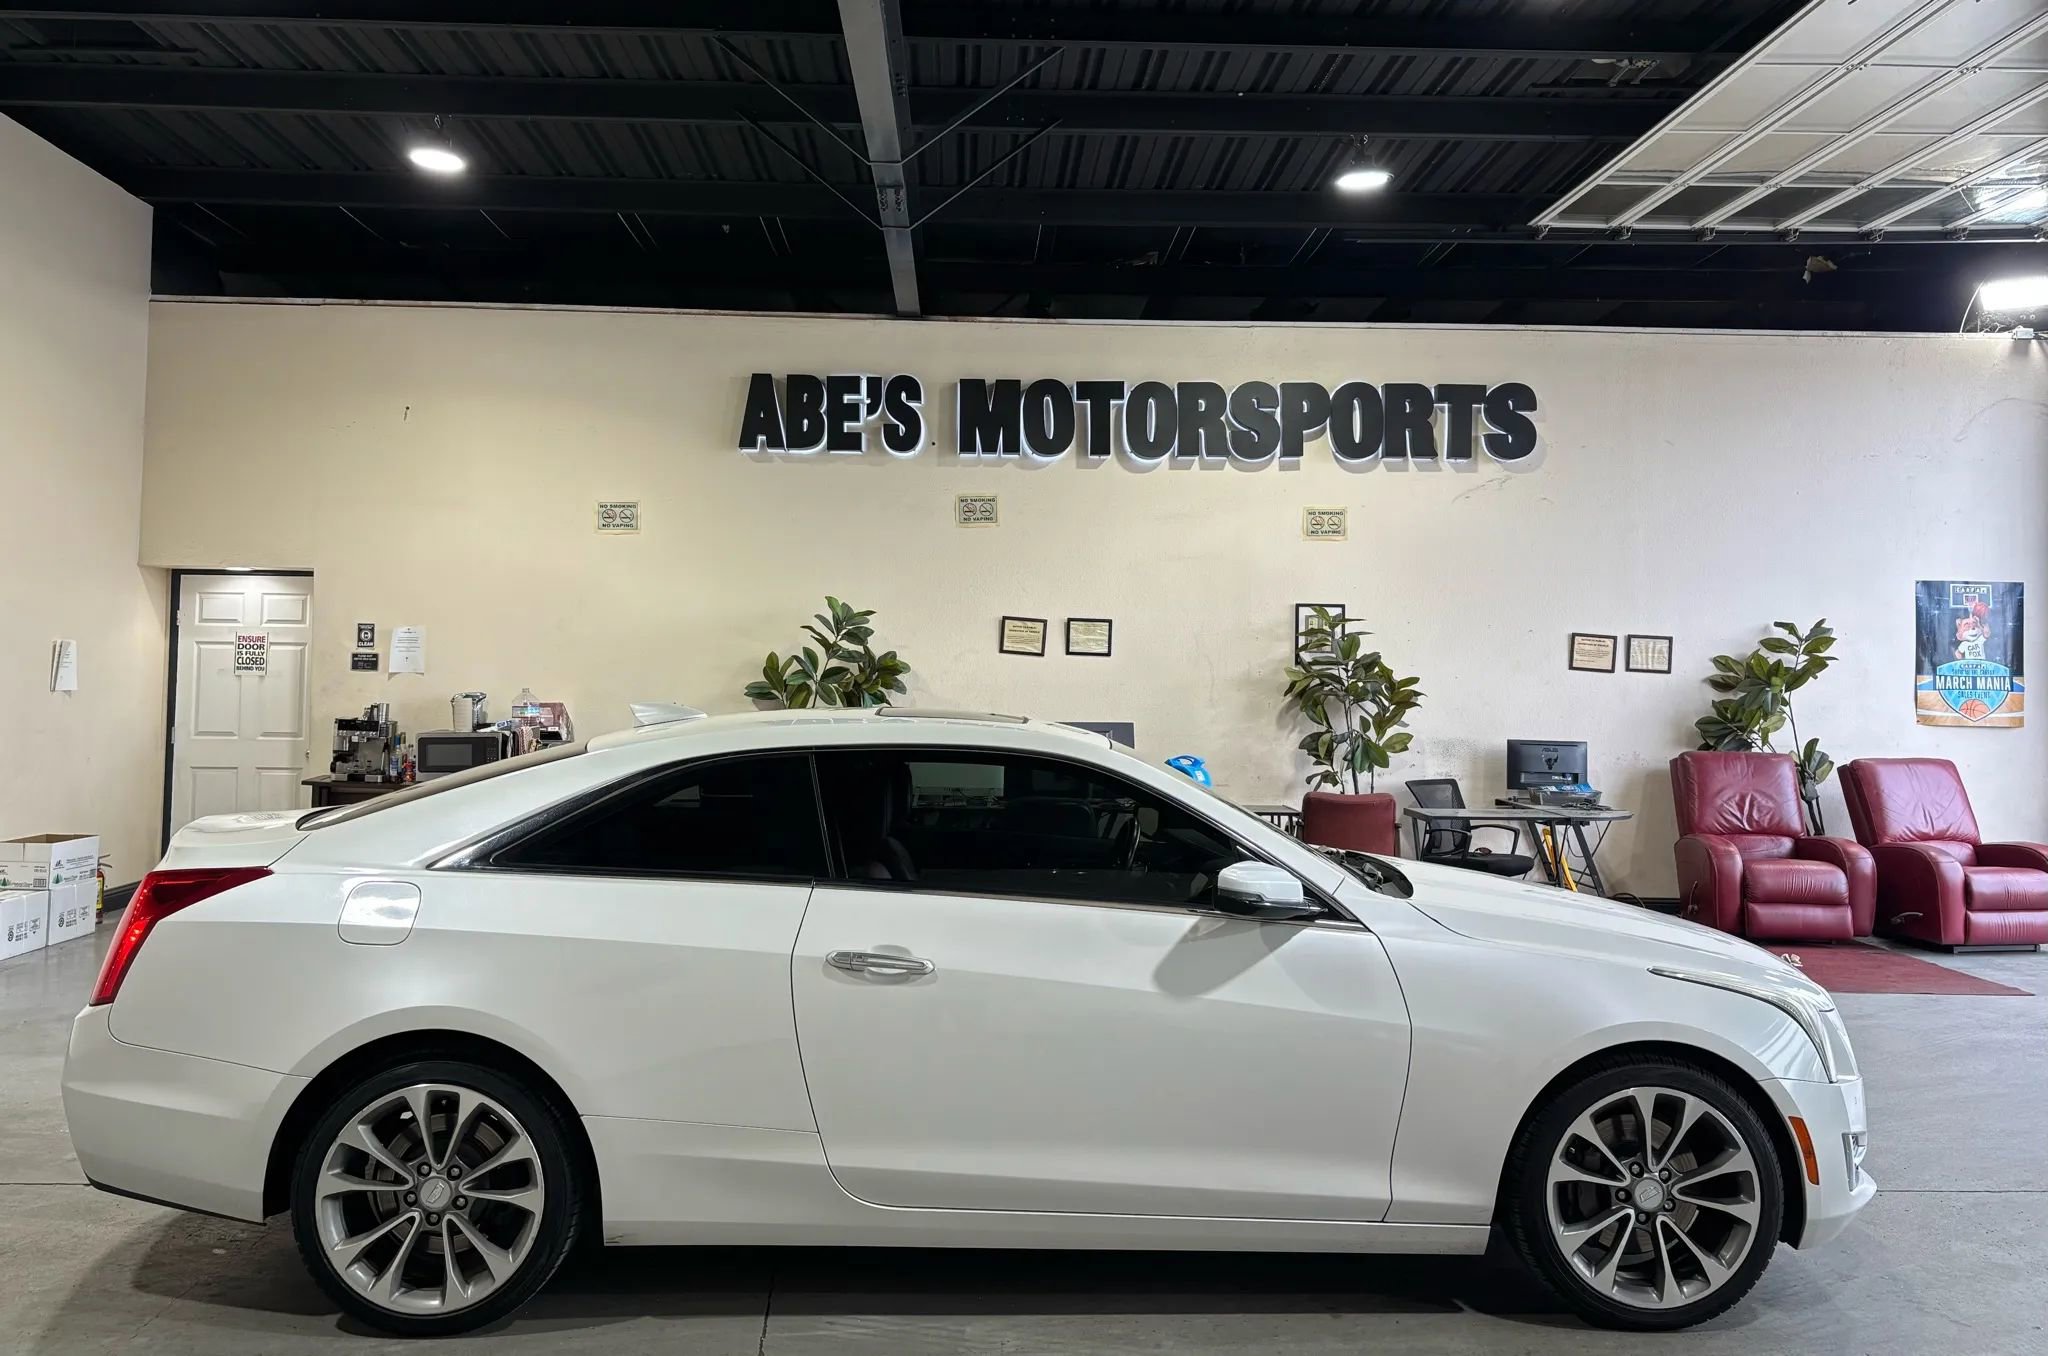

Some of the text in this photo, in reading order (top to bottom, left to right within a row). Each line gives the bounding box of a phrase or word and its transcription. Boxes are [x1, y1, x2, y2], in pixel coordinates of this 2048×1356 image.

[738, 373, 1539, 461] ABE'S MOTORSPORTS
[237, 635, 266, 643] ENSURE
[237, 643, 265, 651] DOOR
[1967, 643, 1981, 651] CAR
[236, 656, 266, 666] CLOSED
[1935, 675, 2011, 691] MARCH MANIA
